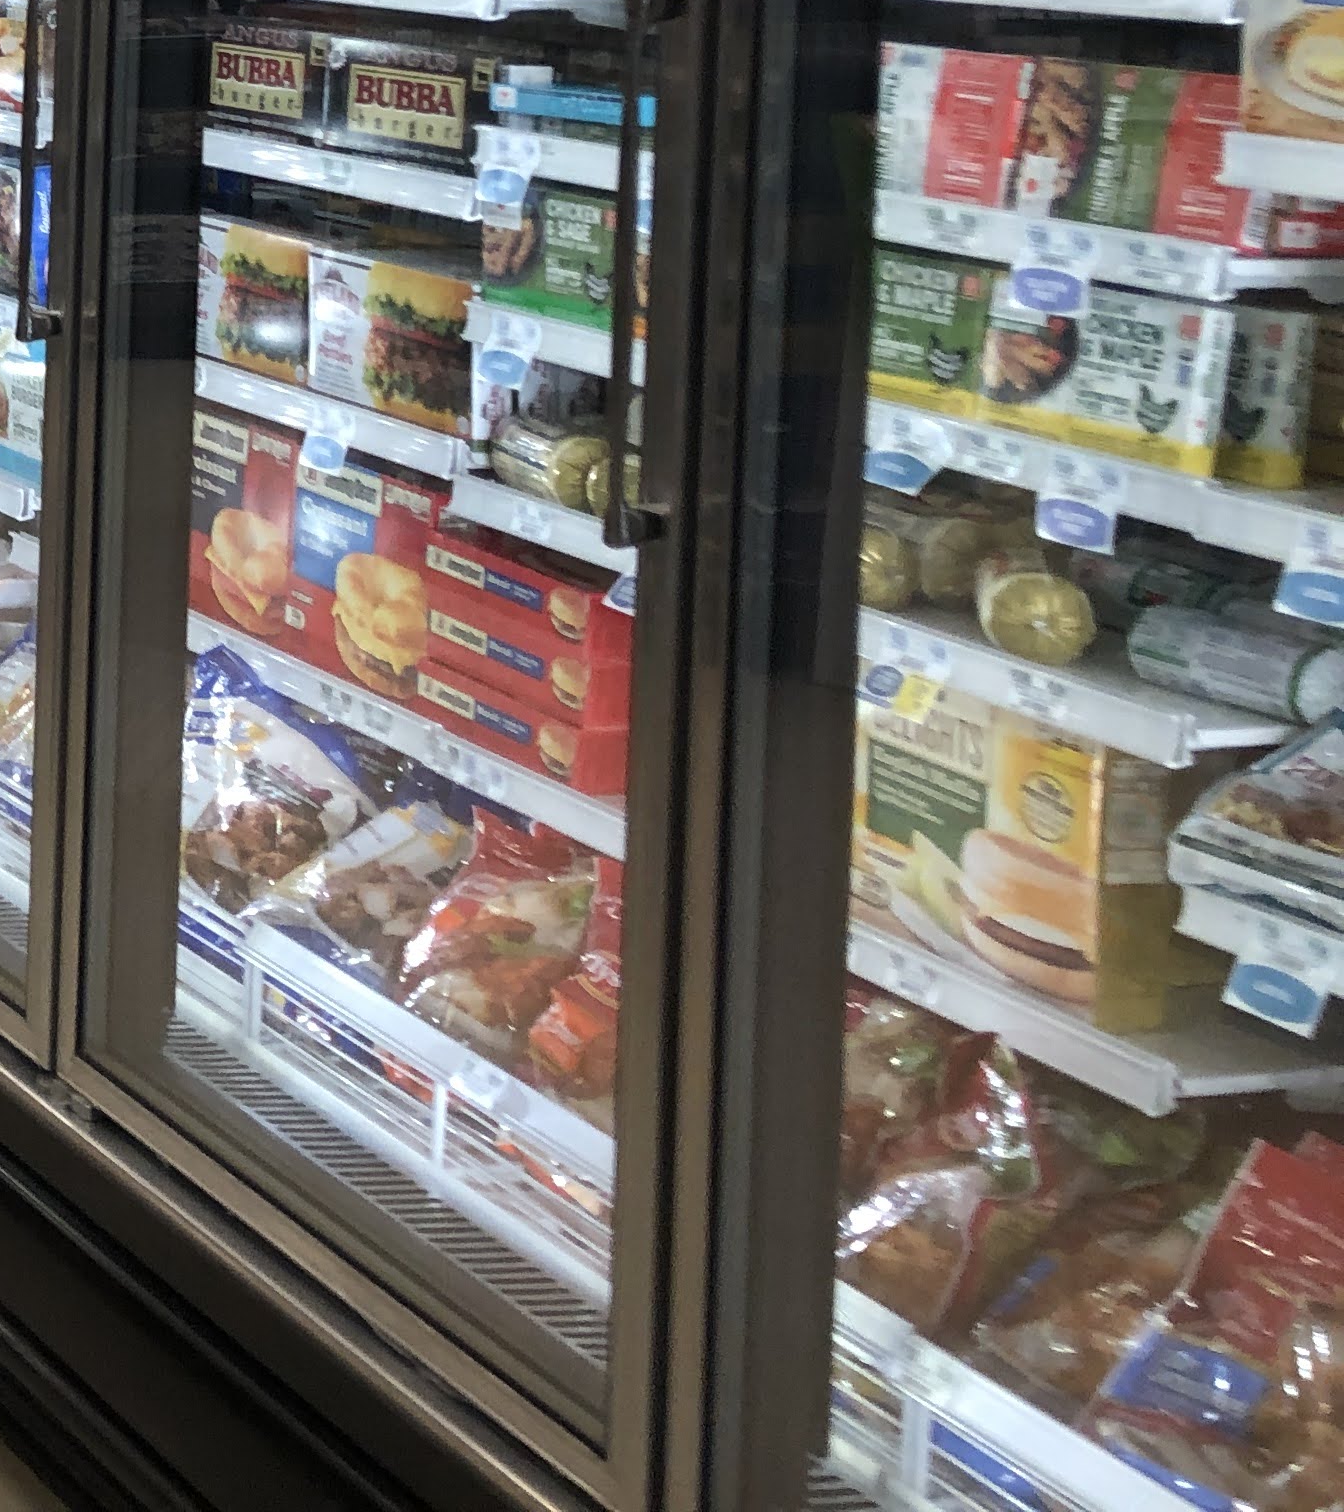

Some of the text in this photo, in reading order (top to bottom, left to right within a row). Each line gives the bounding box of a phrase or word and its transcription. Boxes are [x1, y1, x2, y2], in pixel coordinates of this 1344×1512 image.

[220, 23, 299, 50] ANGUS
[216, 51, 297, 88] BUBBA
[355, 74, 457, 117] BUBBA
